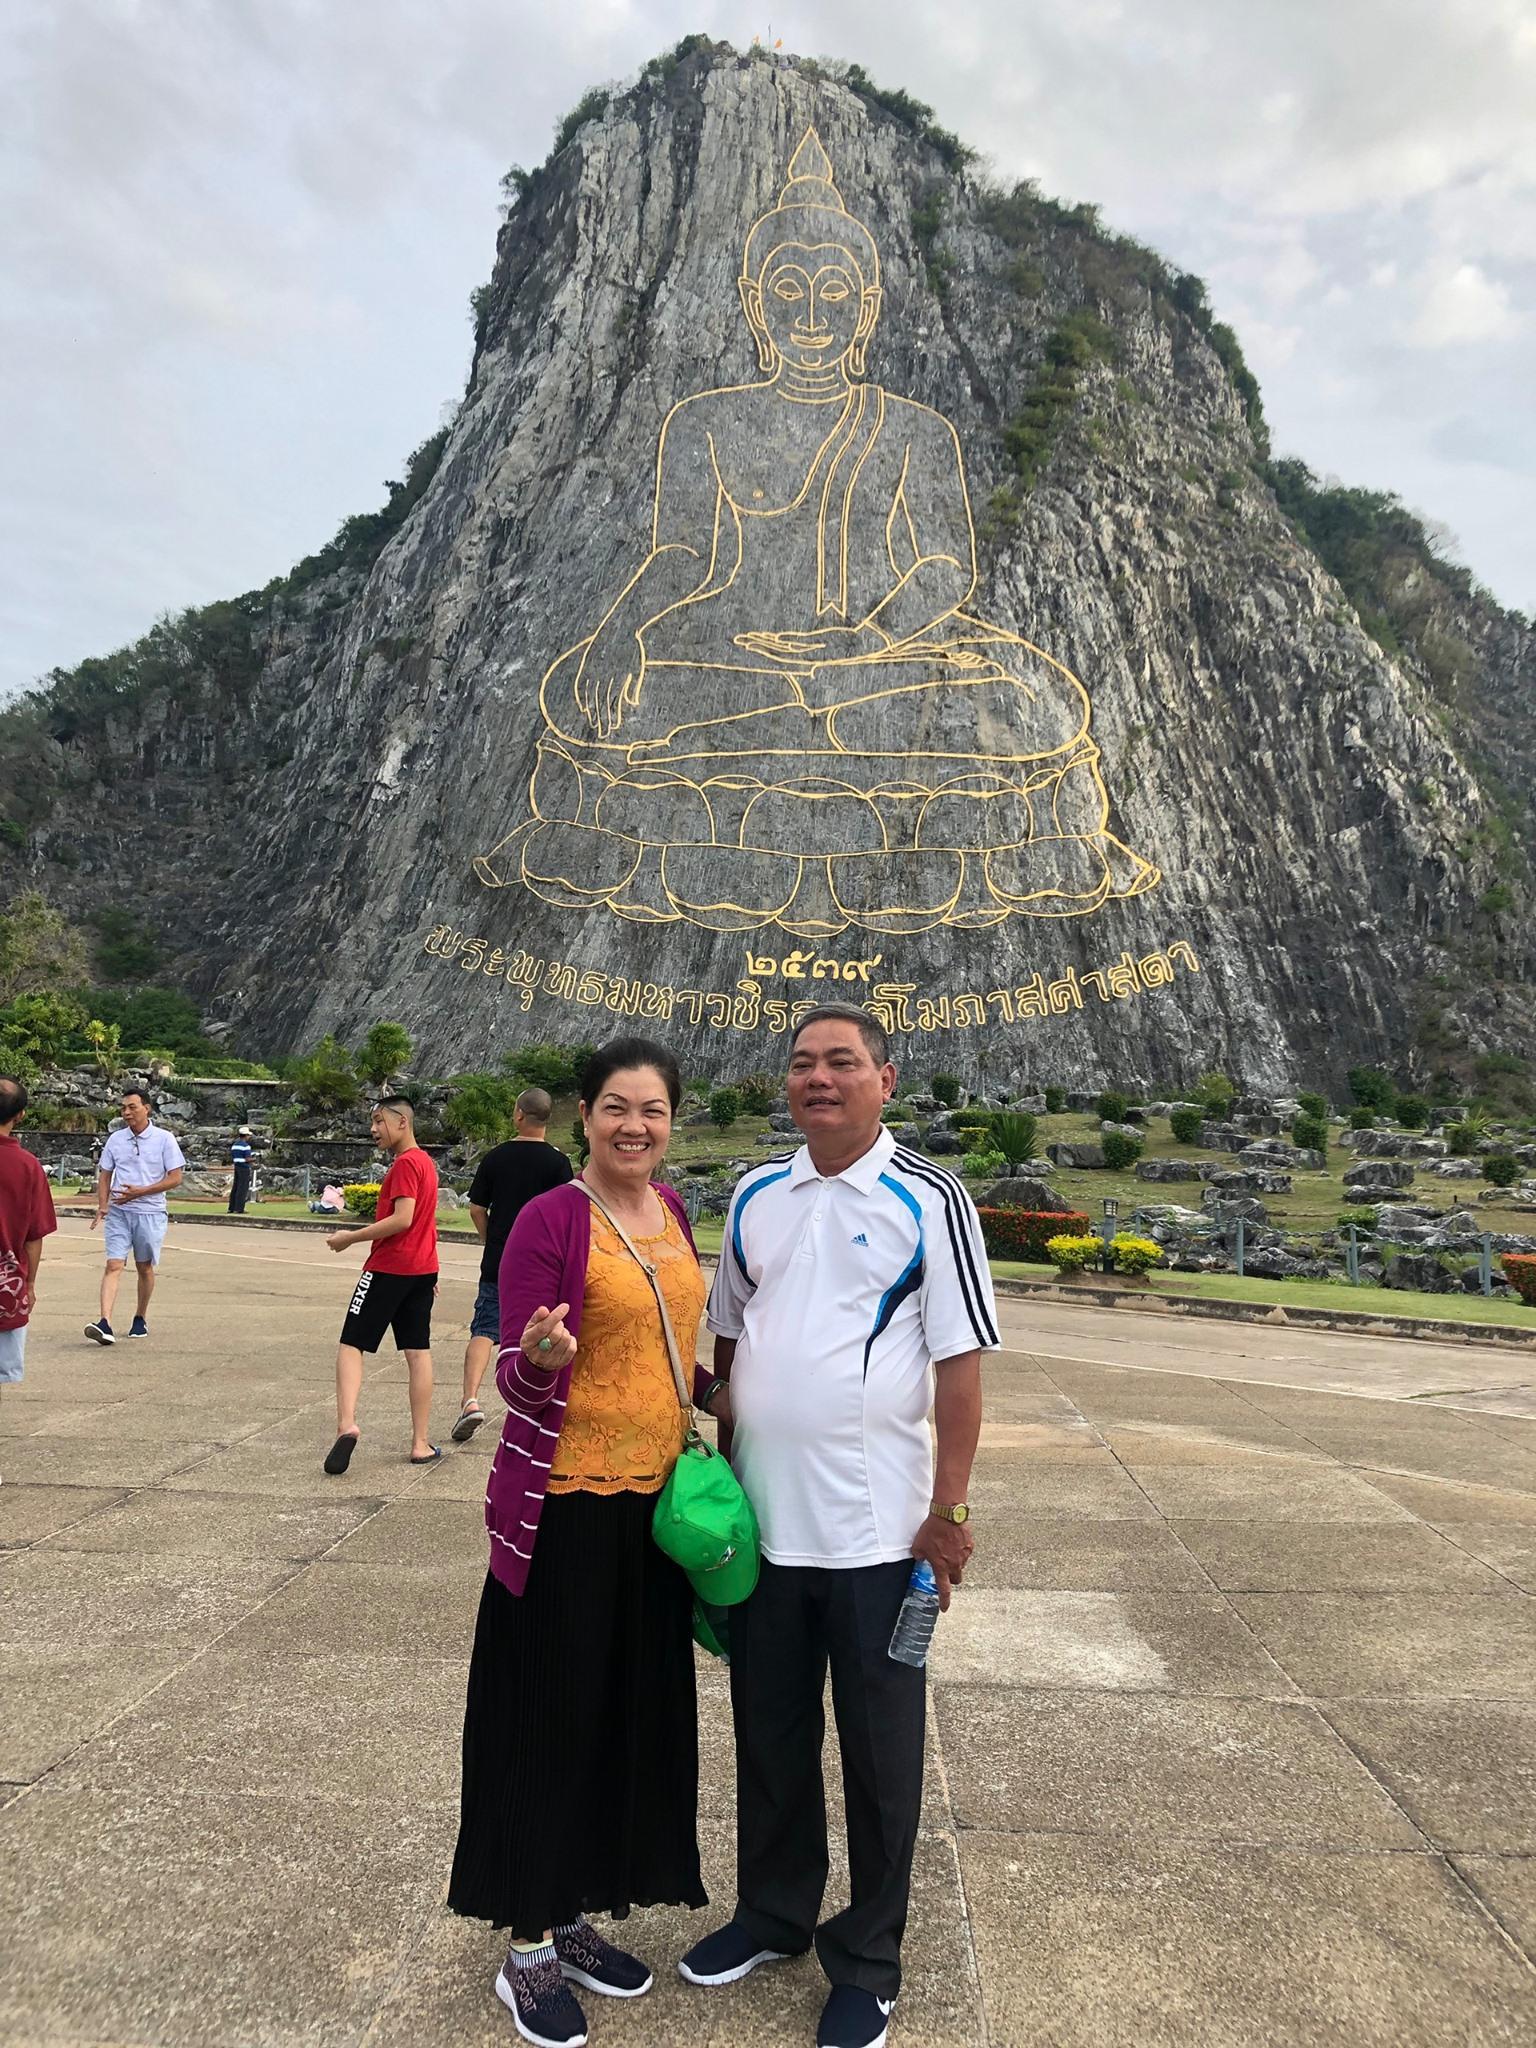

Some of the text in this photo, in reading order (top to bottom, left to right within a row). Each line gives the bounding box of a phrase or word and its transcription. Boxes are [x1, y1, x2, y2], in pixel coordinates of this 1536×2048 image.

[746, 950, 882, 982] ๒๕๓๙
[562, 1939, 602, 1971] SPORT
[516, 1974, 537, 2014] SPORT
